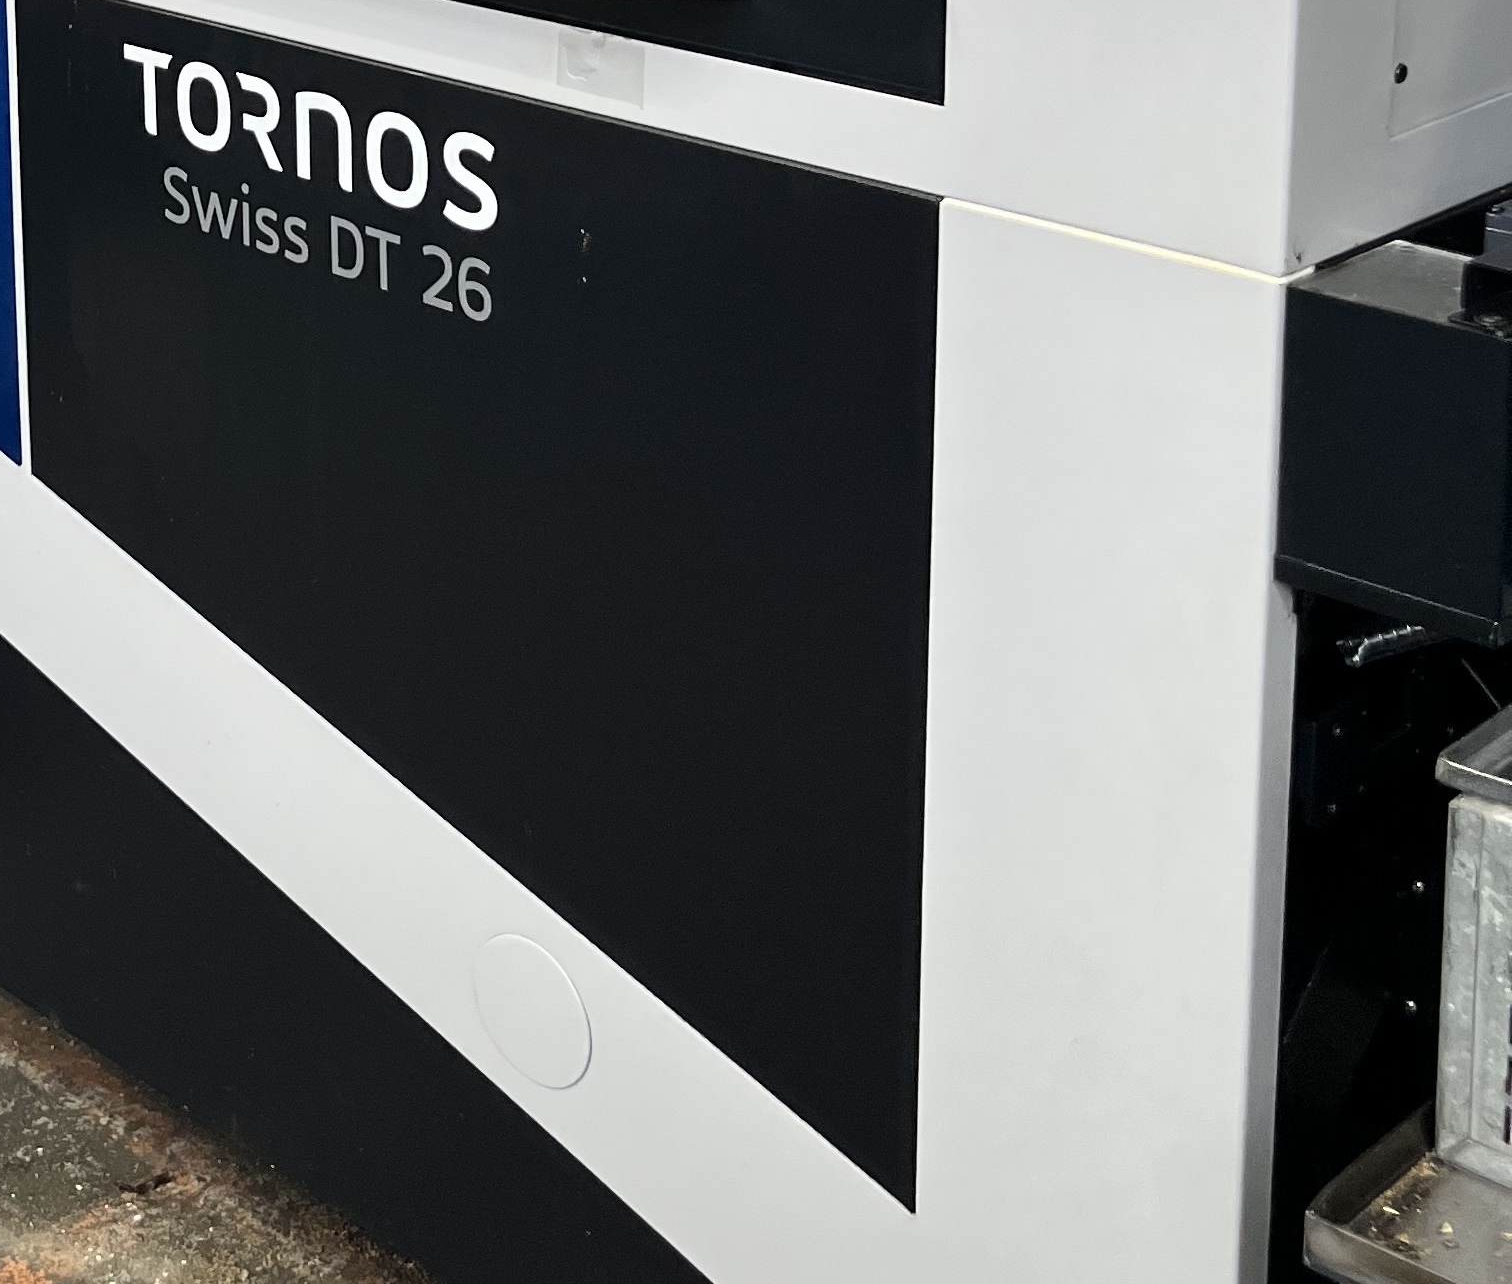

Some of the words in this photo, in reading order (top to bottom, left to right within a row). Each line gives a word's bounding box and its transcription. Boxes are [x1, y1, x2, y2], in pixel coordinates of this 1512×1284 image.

[123, 43, 498, 231] TORNOS
[163, 166, 309, 264] Swiss
[331, 216, 401, 291] DT
[422, 245, 492, 322] 26
